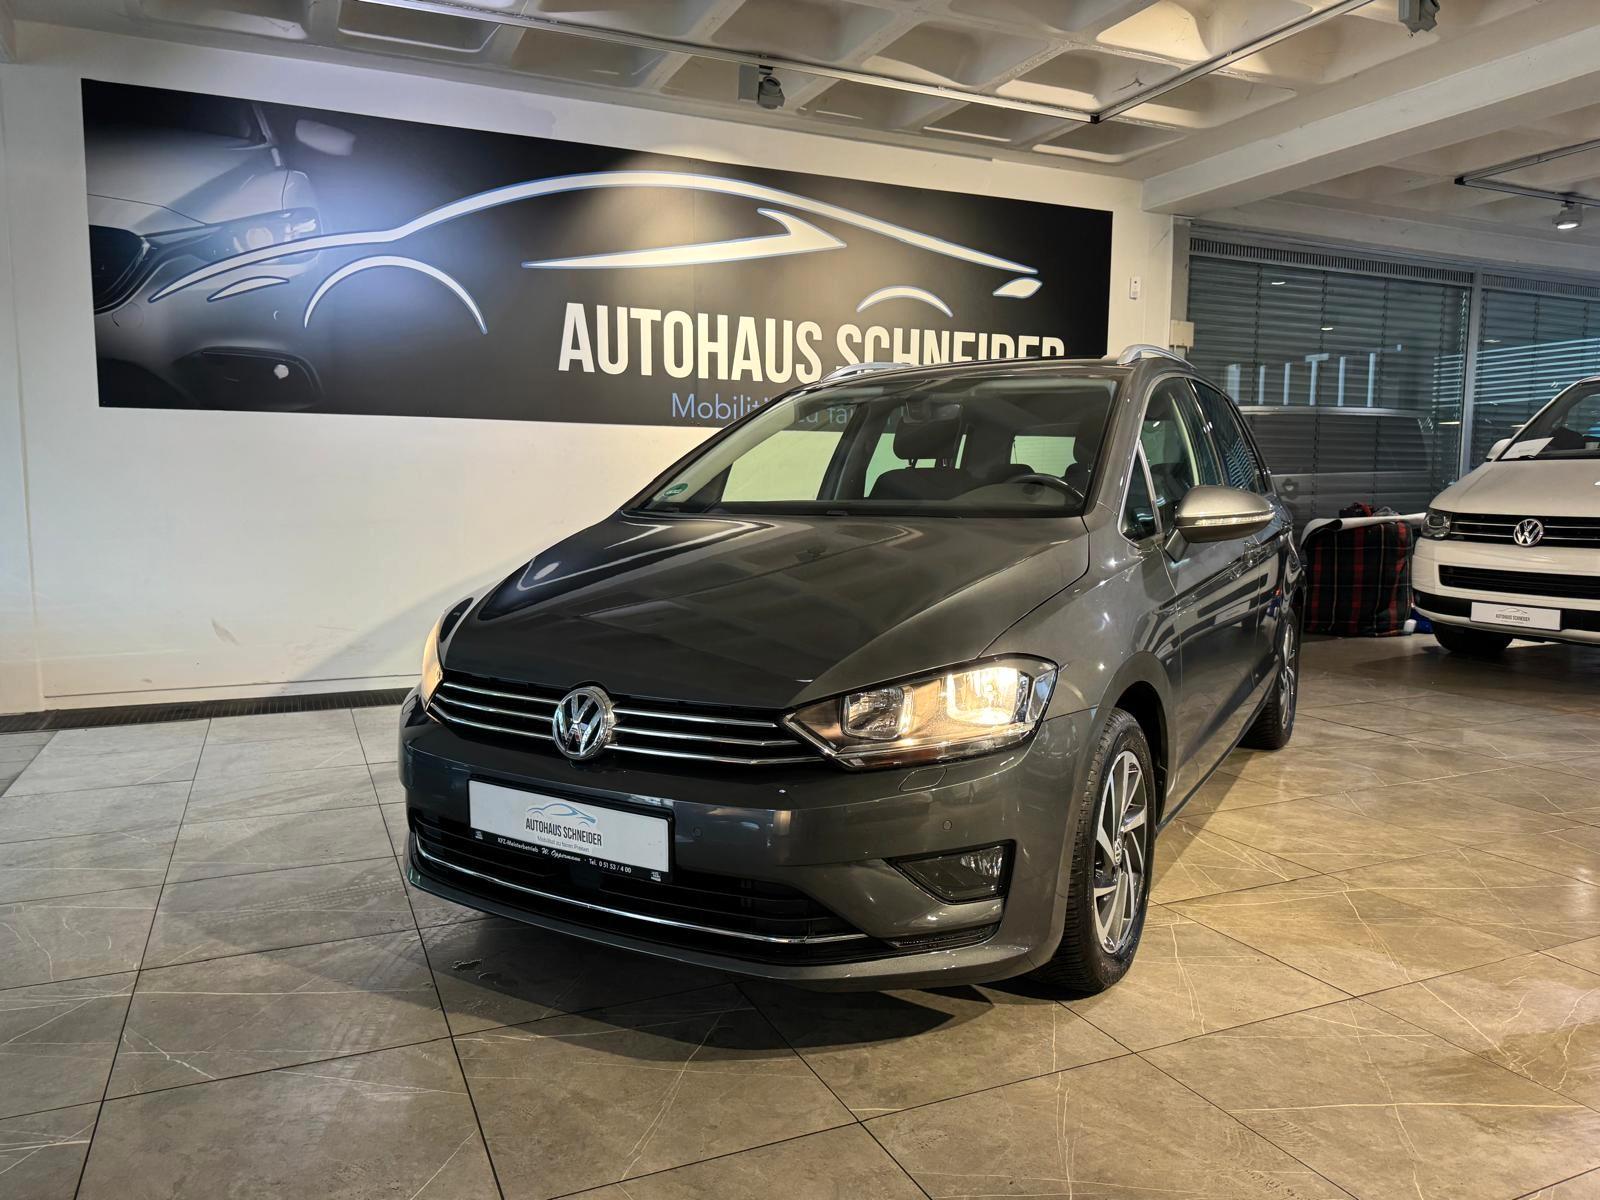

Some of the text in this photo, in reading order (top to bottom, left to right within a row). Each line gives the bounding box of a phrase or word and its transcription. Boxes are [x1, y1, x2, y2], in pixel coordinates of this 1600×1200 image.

[558, 302, 822, 384] AUTOHAUS
[525, 817, 602, 846] AUTOHAUS SCHNEIDER
[497, 837, 539, 853] KFZ-Meisterbetrieb
[589, 858, 597, 866] Tel.
